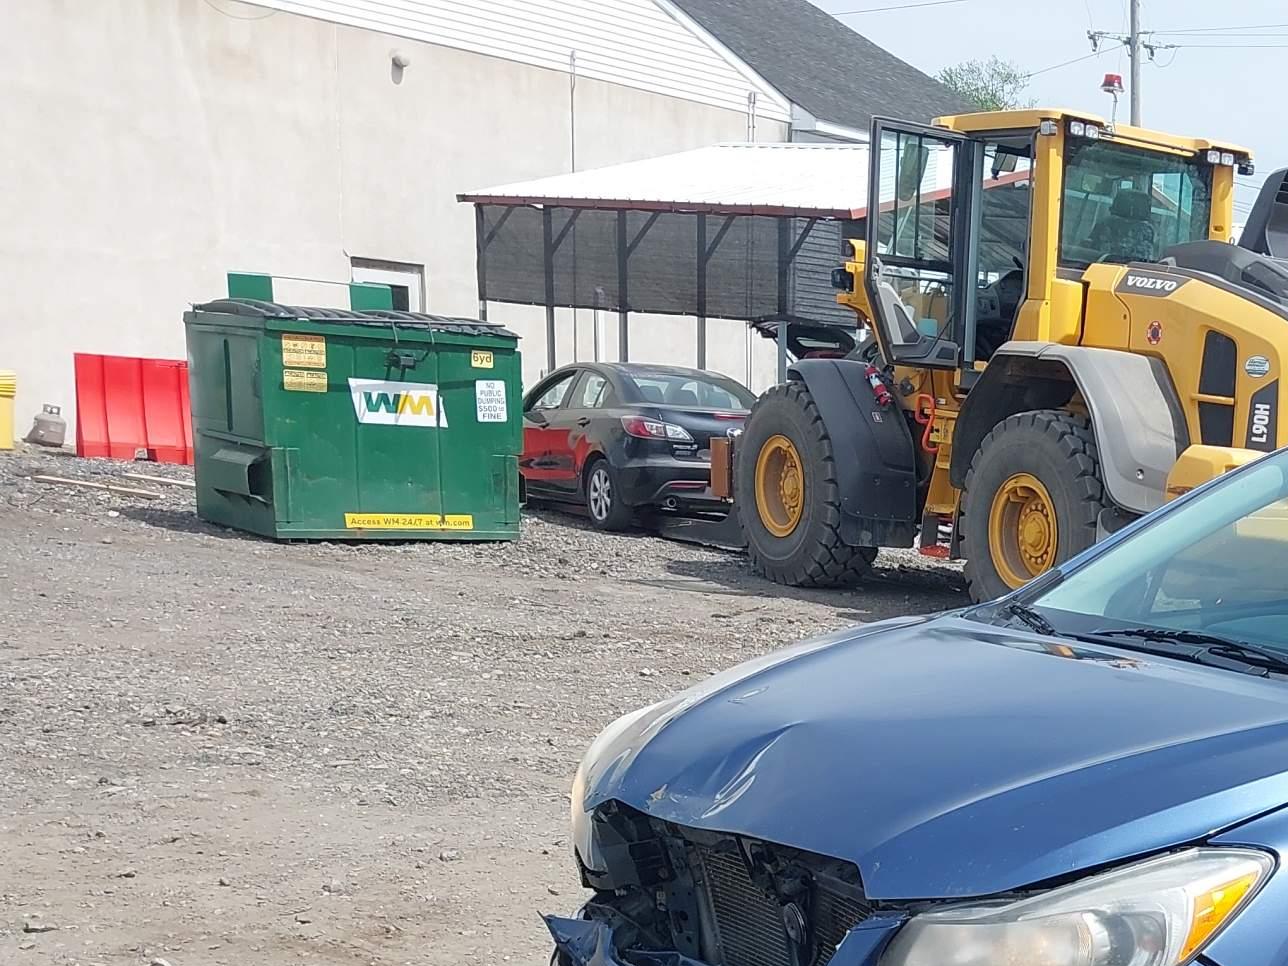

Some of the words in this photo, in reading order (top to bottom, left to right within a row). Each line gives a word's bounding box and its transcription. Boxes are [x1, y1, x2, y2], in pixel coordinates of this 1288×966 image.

[1127, 275, 1177, 291] VOLVO
[473, 352, 492, 365] 6yd
[485, 382, 495, 390] NO
[362, 391, 434, 416] WM
[482, 412, 502, 420] FINE
[1251, 403, 1271, 443] L90H
[400, 518, 423, 526] 24/7
